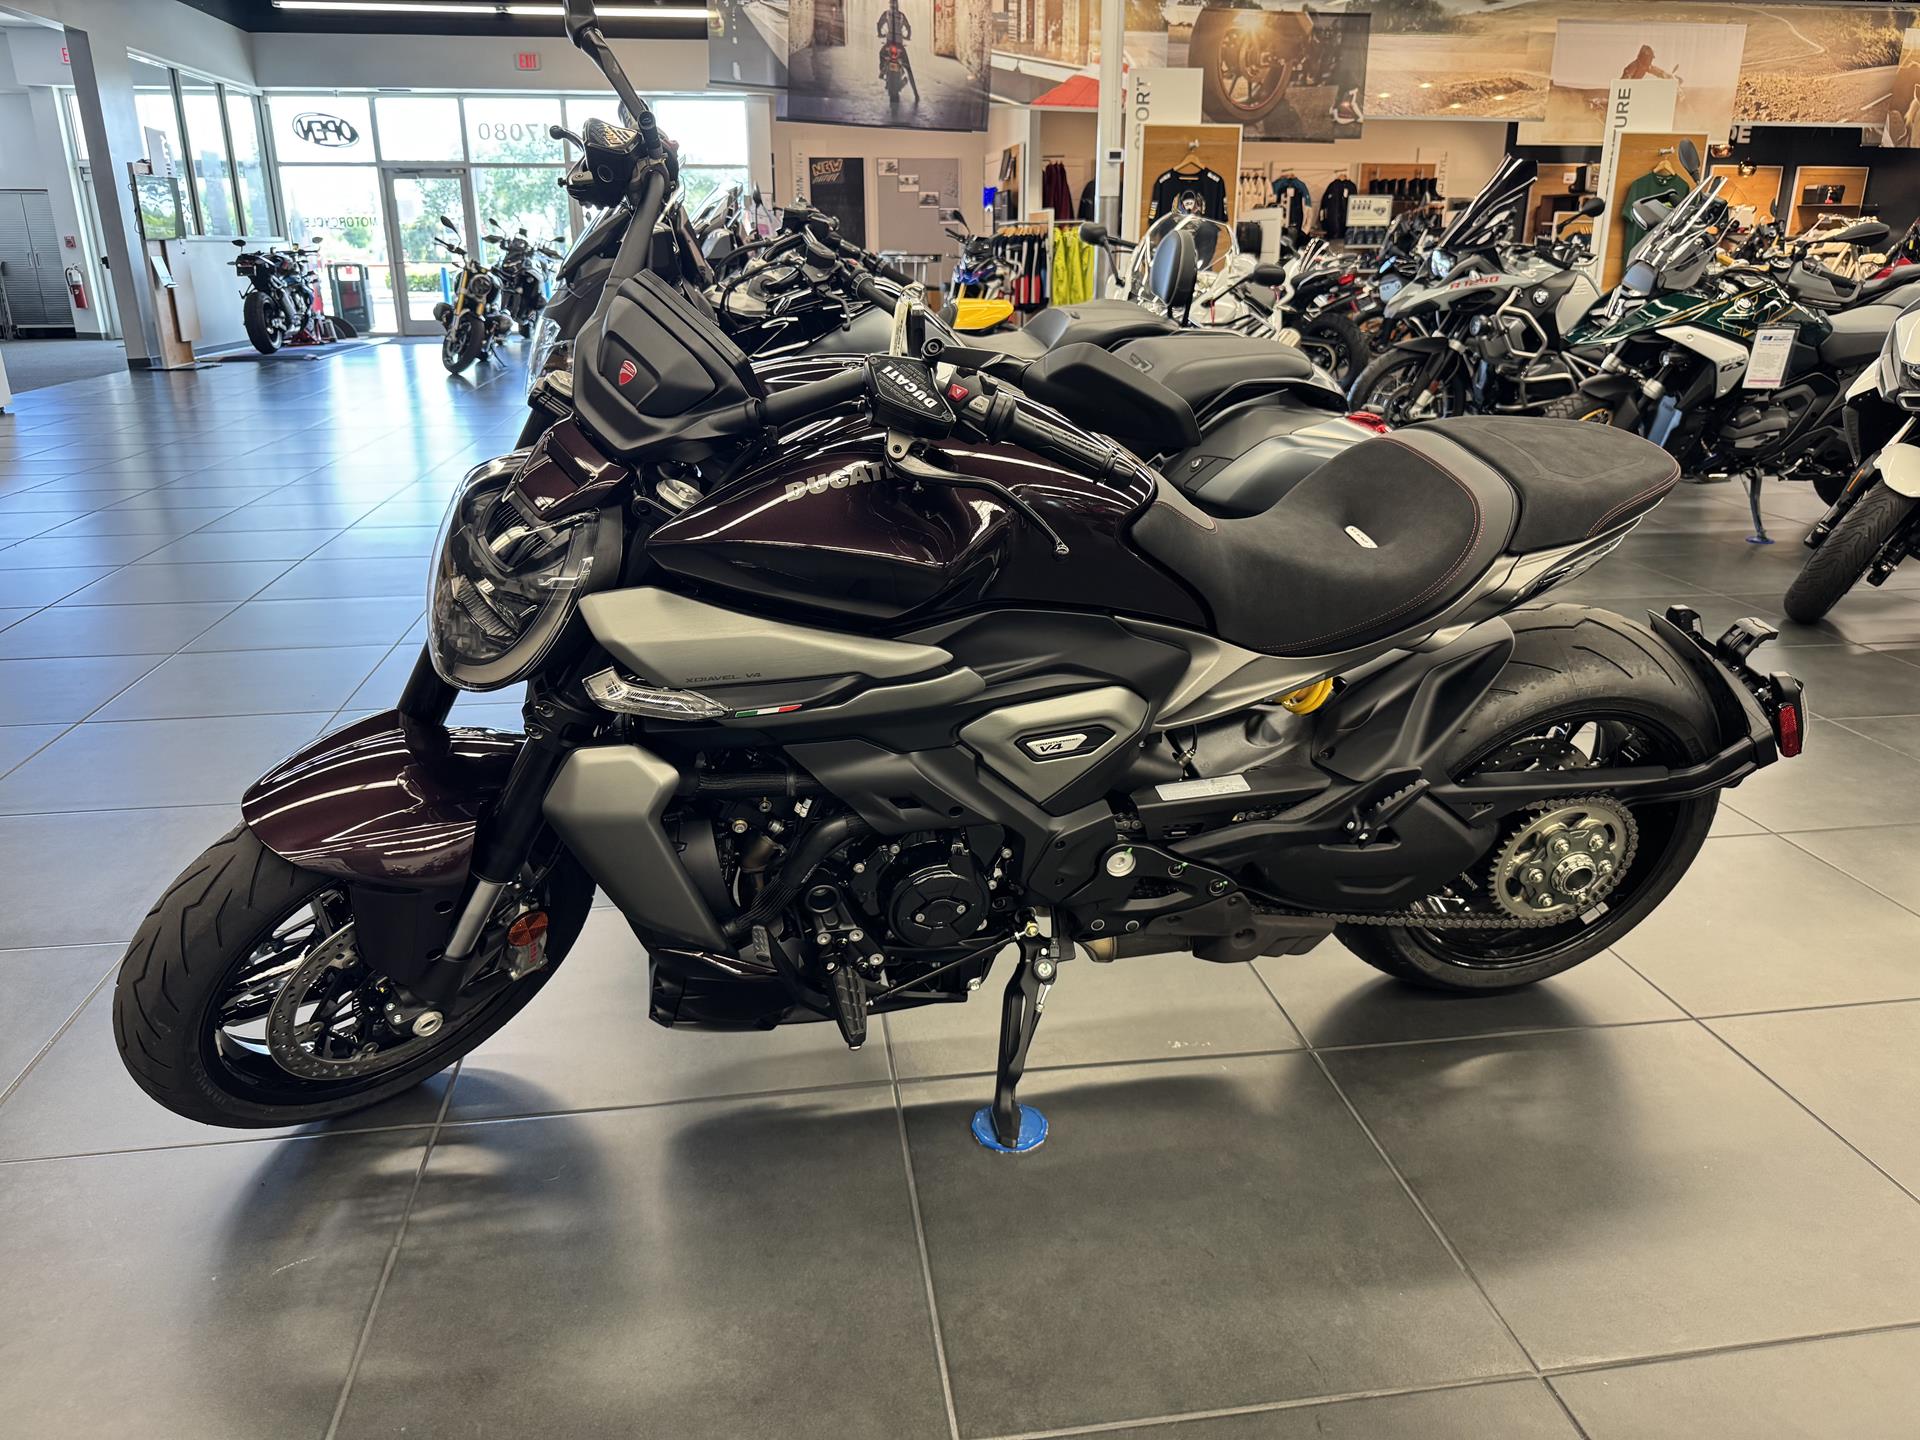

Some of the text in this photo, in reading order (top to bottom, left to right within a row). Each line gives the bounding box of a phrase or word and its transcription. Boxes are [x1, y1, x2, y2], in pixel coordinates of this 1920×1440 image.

[811, 158, 843, 176] NEW
[881, 365, 938, 409] DUCATI
[686, 674, 742, 683] XDIAVEL
[1040, 743, 1063, 753] V4
